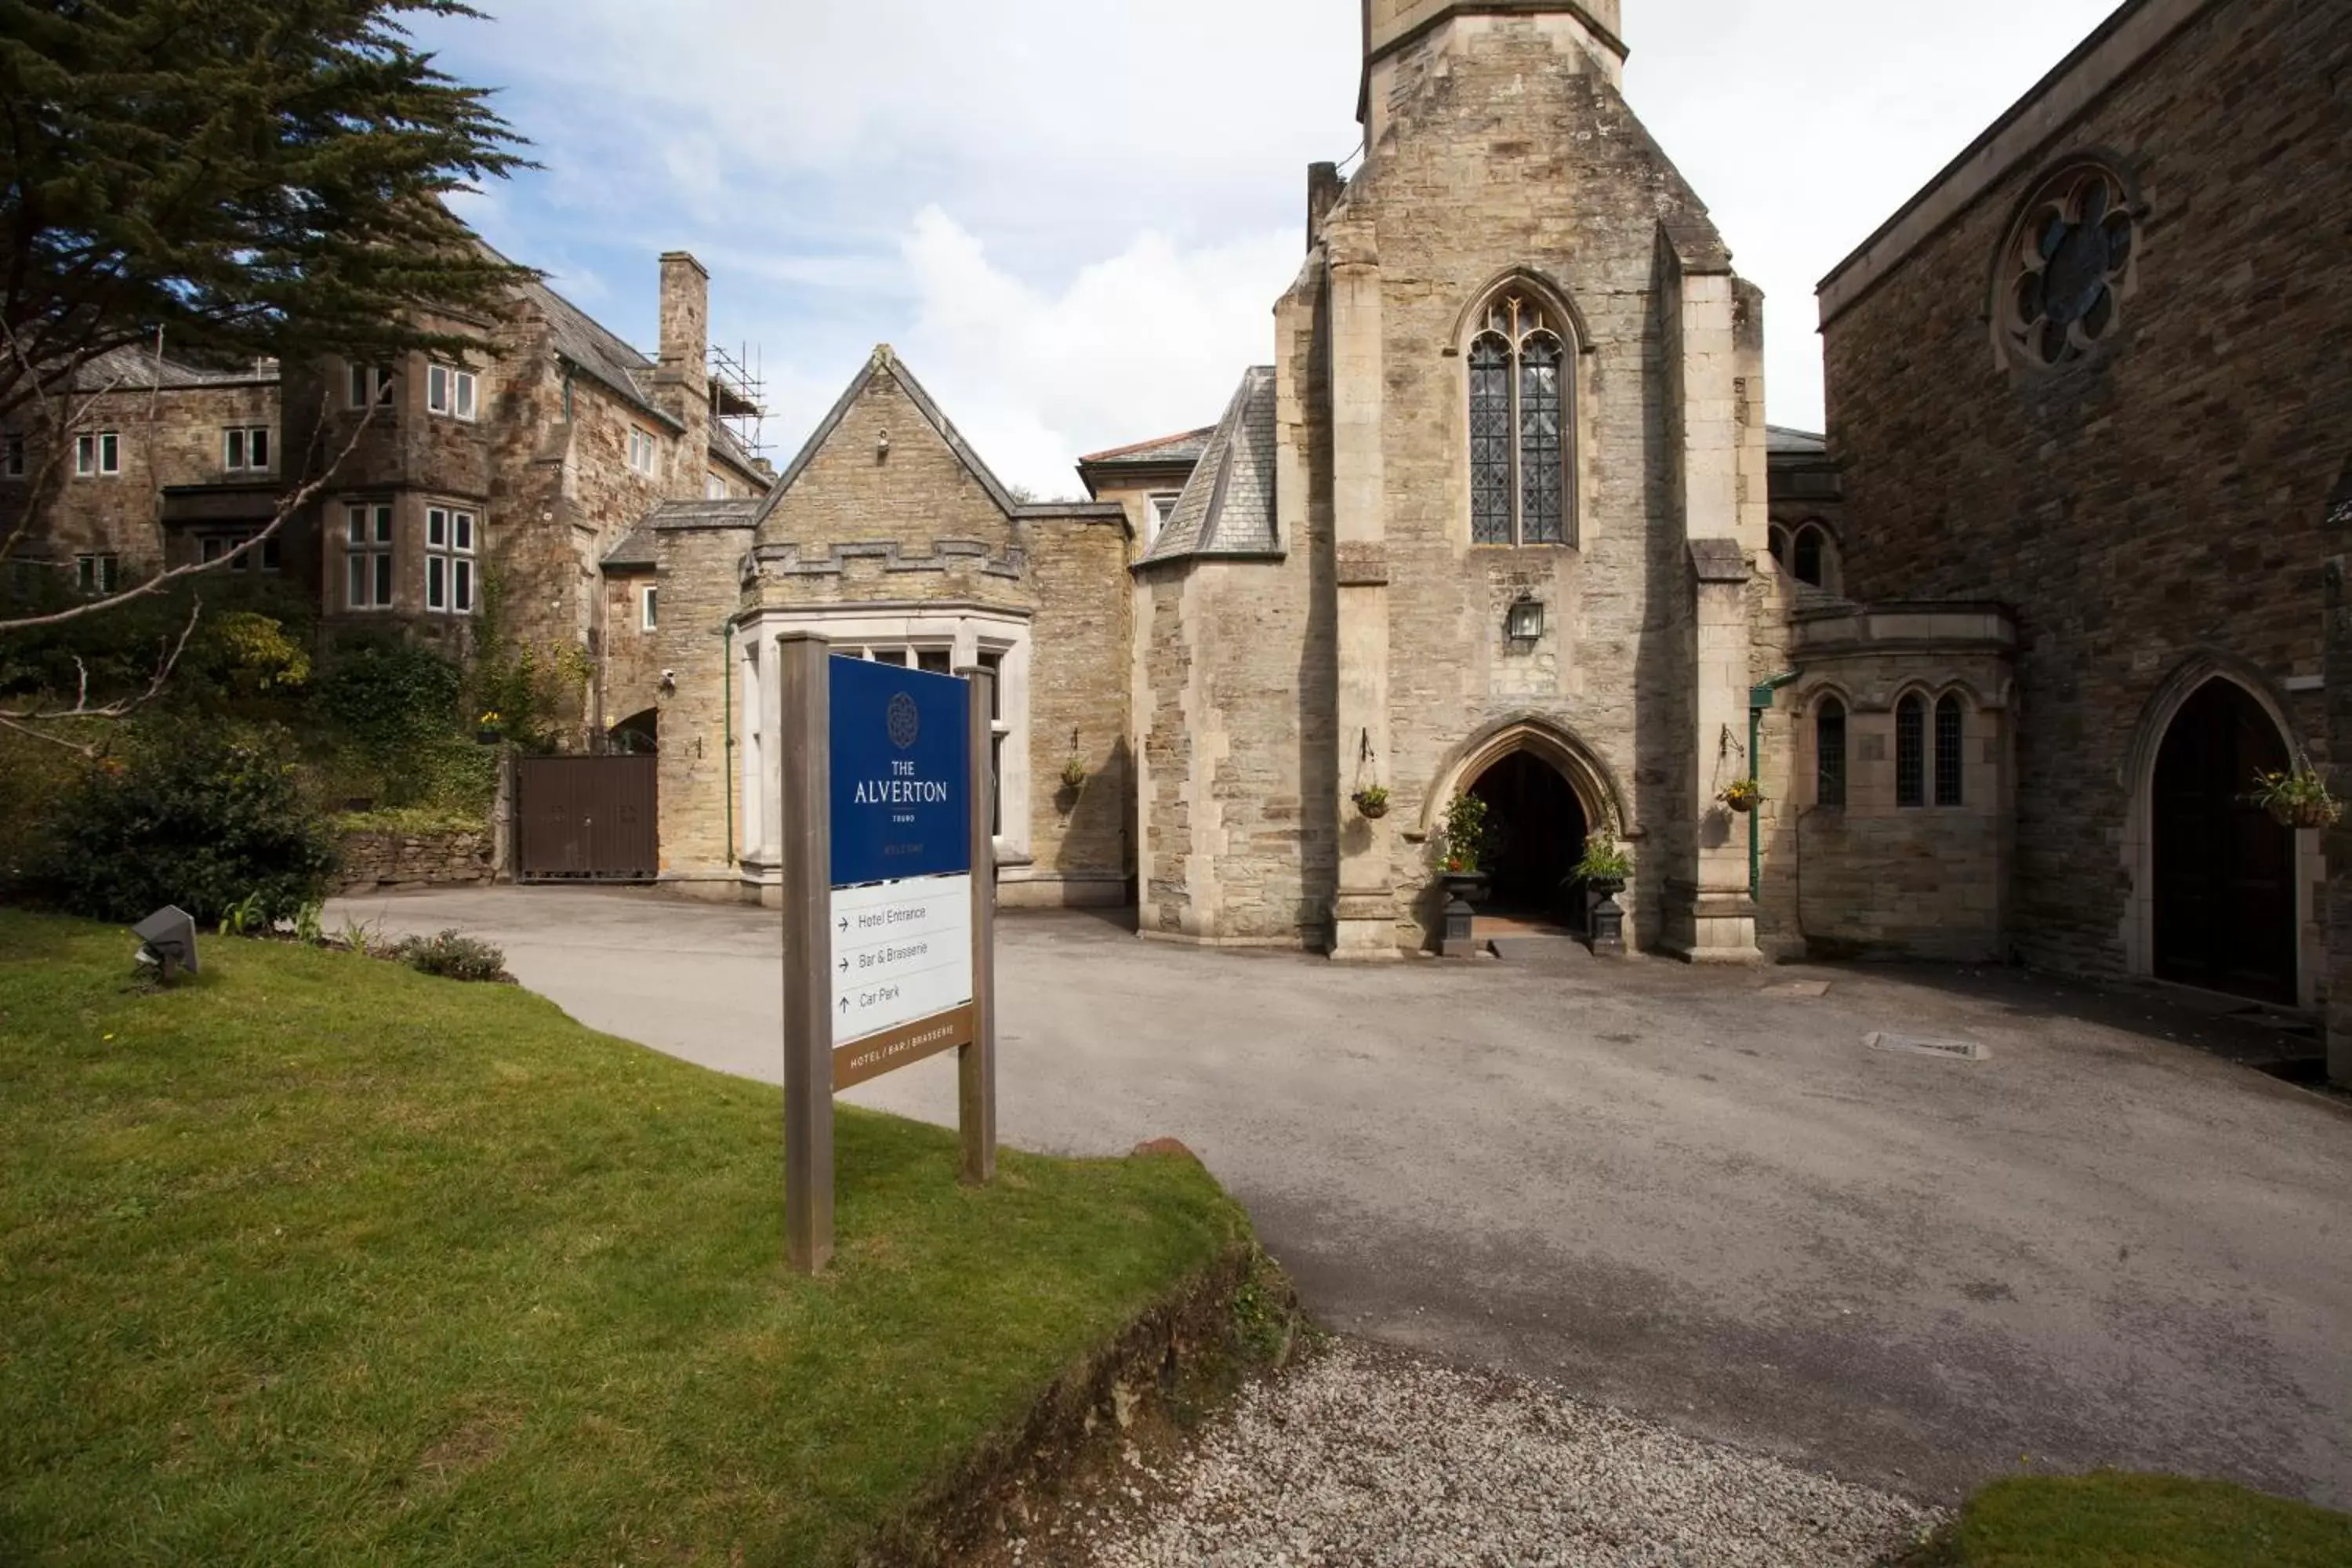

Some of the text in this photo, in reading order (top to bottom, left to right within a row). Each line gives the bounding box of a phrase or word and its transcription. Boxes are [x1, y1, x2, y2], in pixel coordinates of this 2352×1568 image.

[891, 760, 915, 776] THE
[854, 780, 948, 804] ALVERTON
[858, 906, 927, 929] Hotel Entrance
[858, 942, 927, 968] Bar & Brasserie
[859, 985, 900, 1008] Car Park
[850, 1049, 882, 1069] HOTEL
[888, 1041, 906, 1055] BAR
[911, 1025, 954, 1047] BRASSERIE
